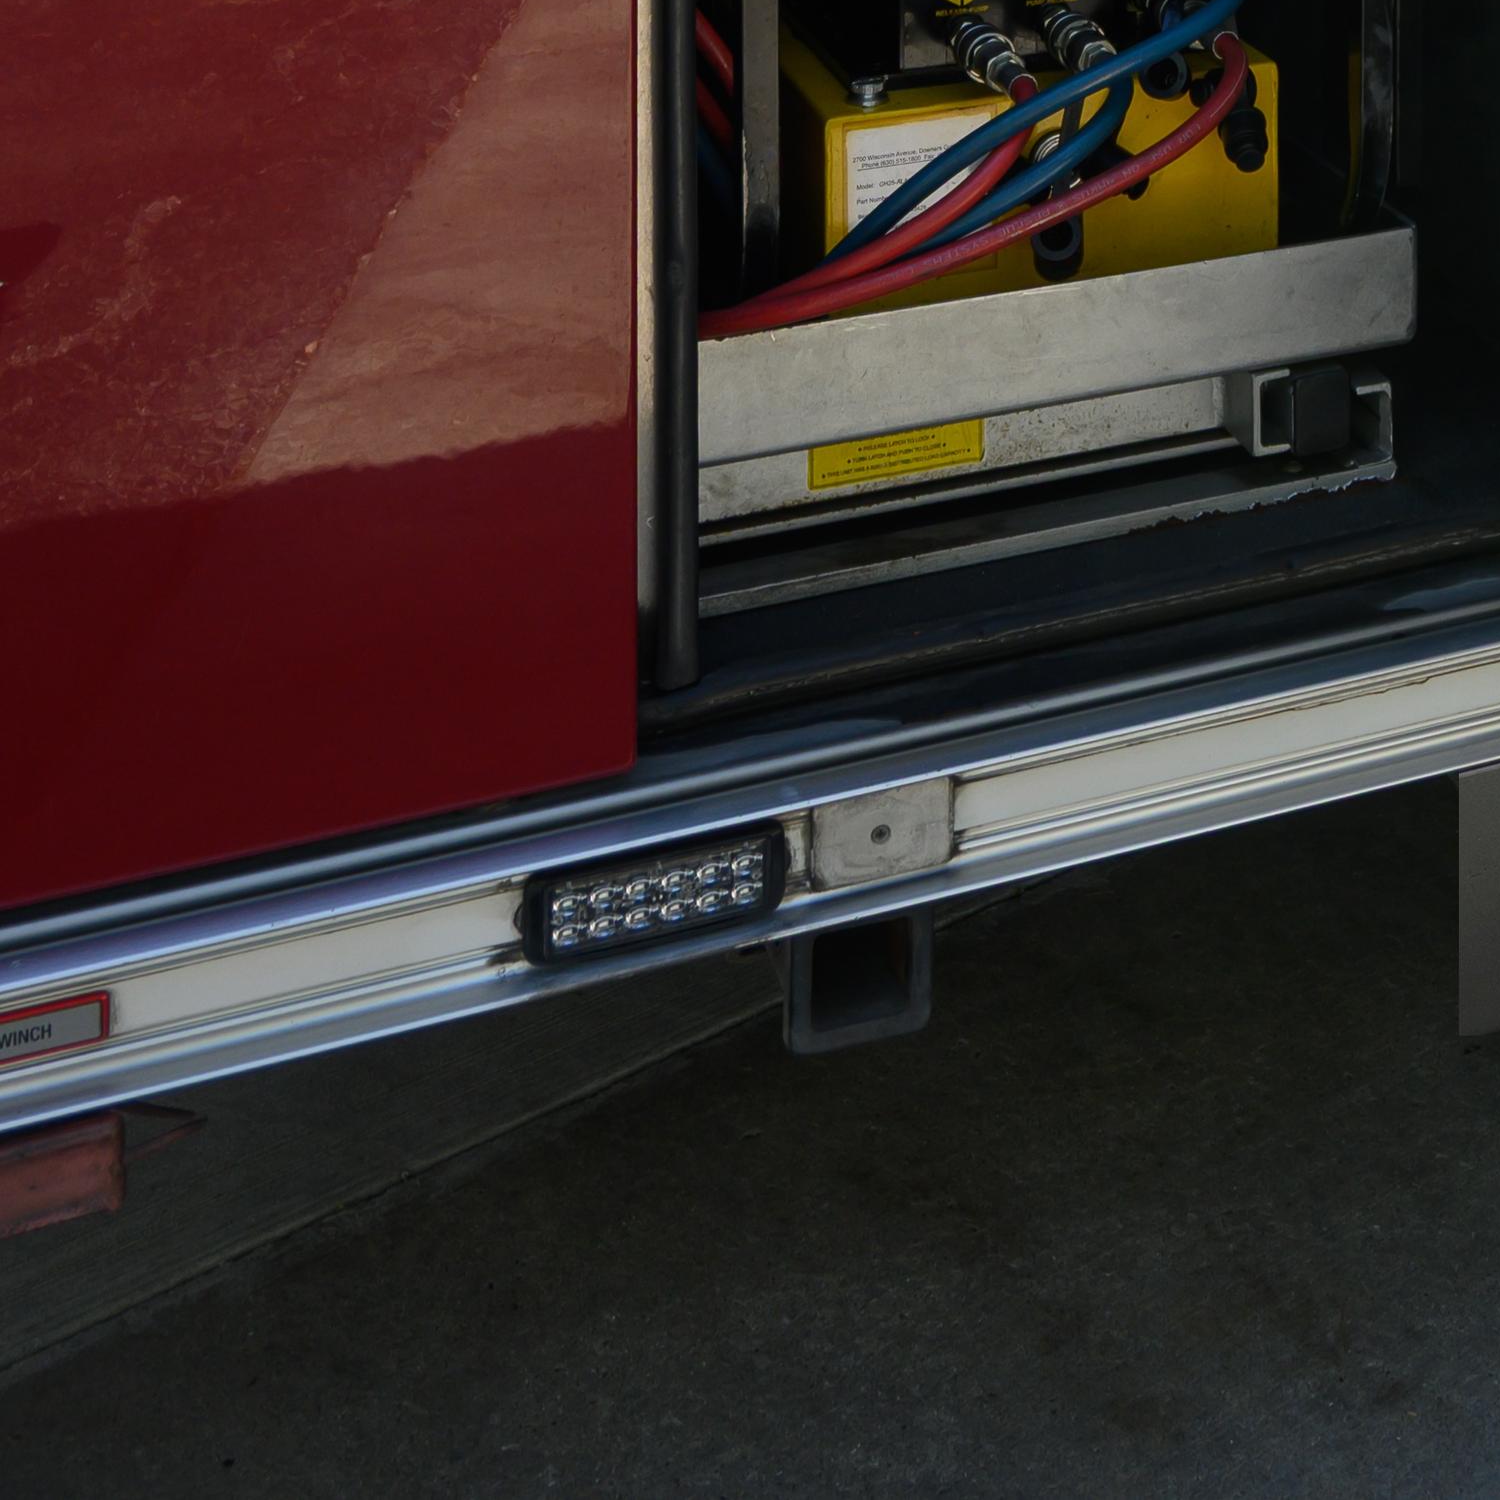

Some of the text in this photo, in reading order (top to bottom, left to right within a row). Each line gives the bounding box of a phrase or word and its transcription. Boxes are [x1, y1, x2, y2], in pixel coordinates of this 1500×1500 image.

[867, 151, 895, 161] Wisconsin
[919, 146, 942, 154] Downers
[861, 161, 879, 169] Phone
[880, 158, 894, 167] (630)
[857, 197, 869, 205] Part
[0, 1023, 52, 1048] WINCH
